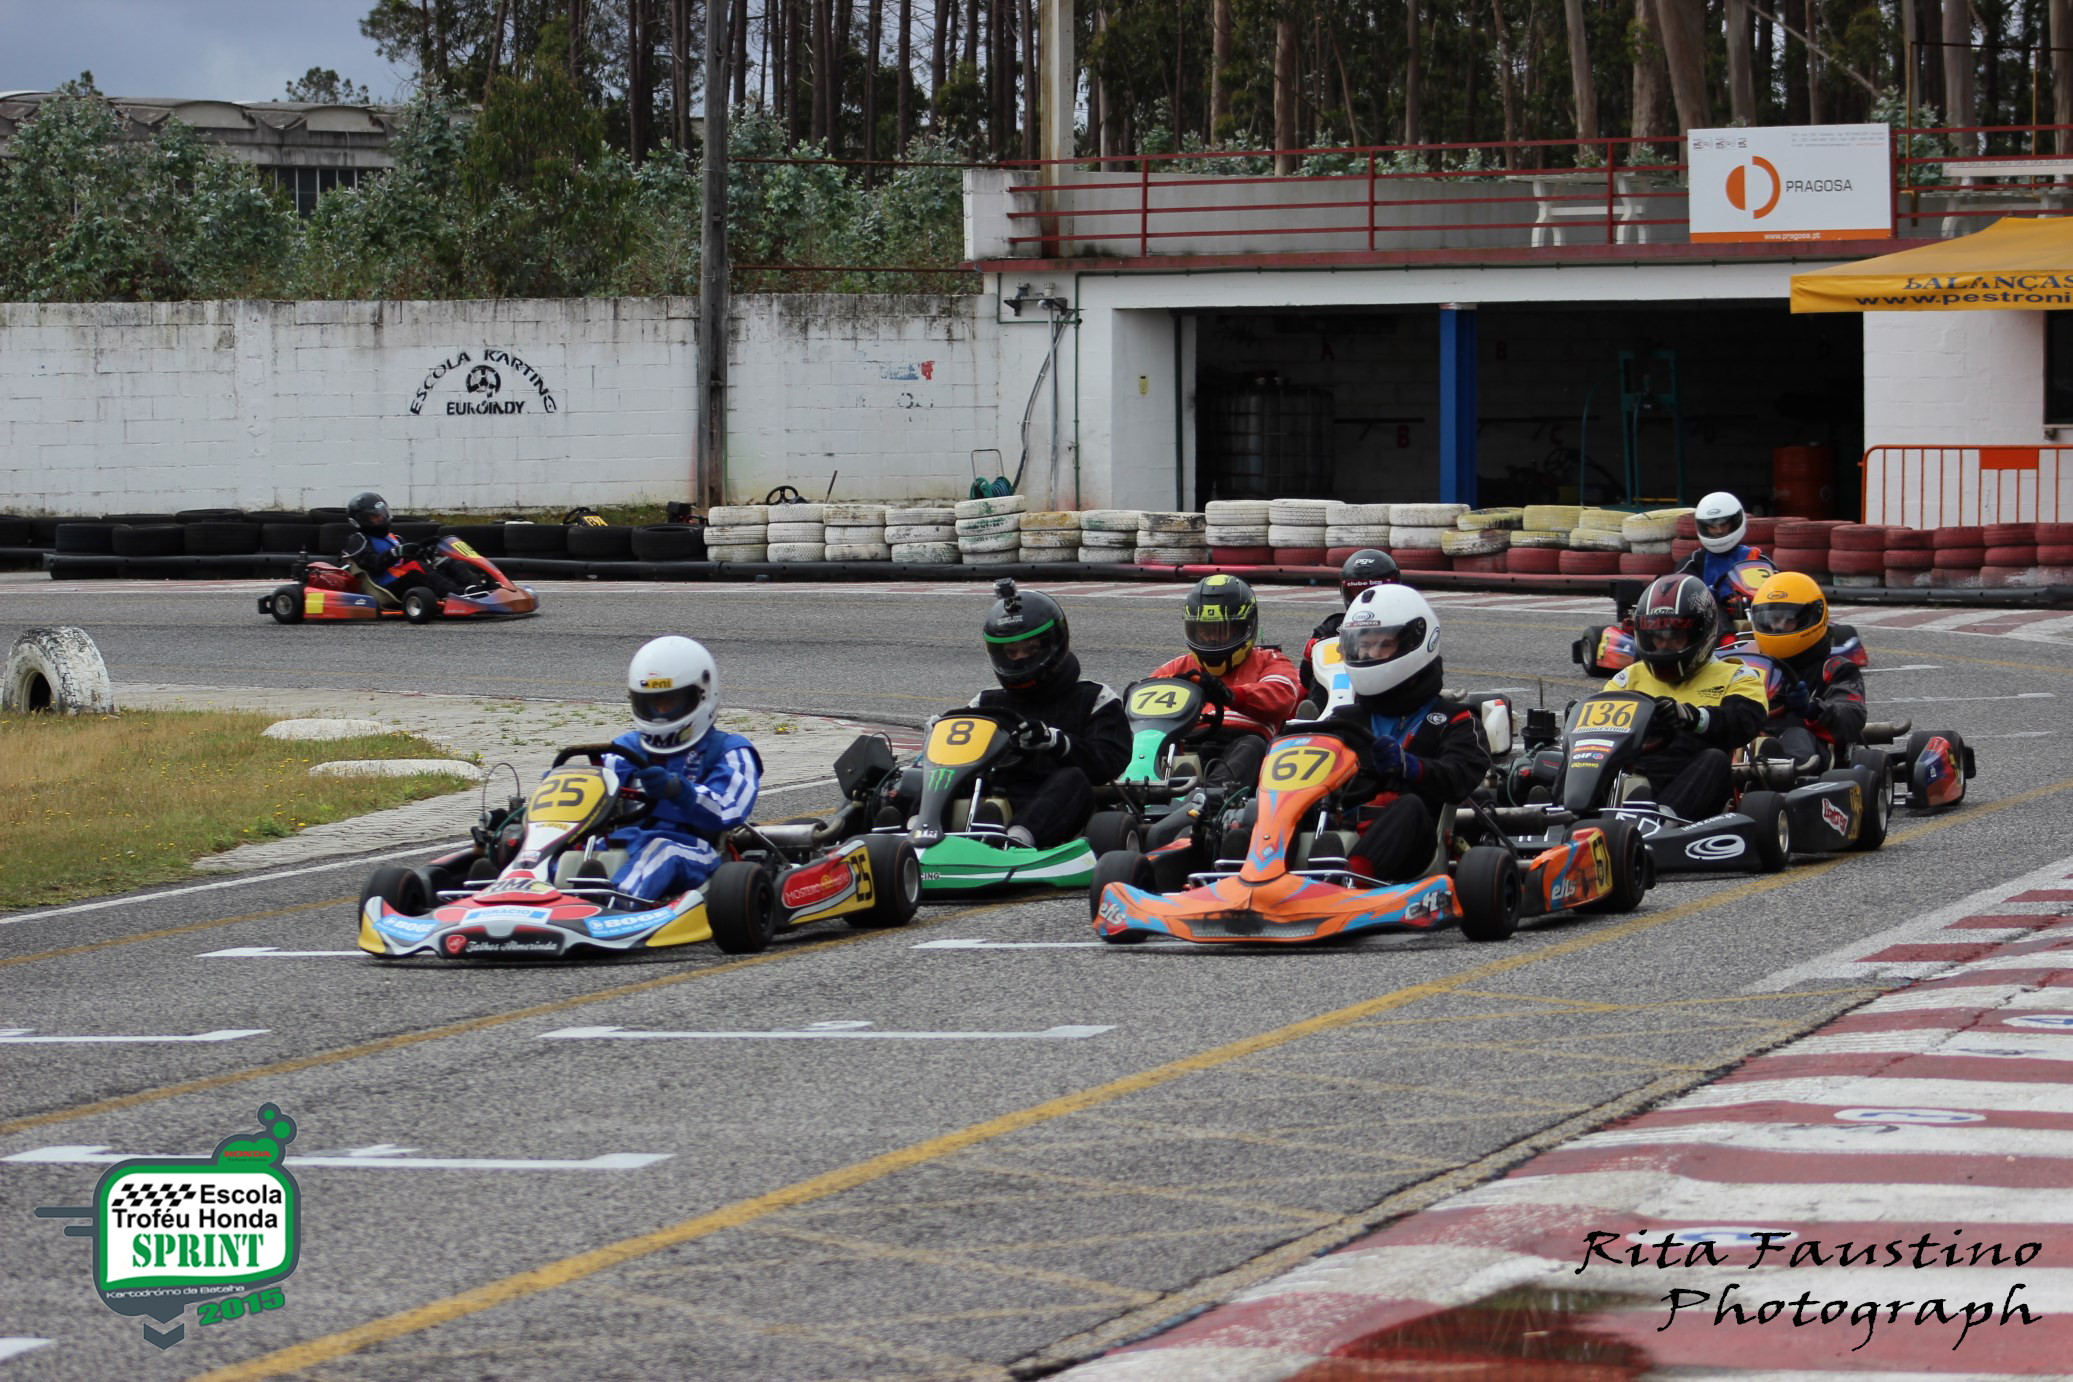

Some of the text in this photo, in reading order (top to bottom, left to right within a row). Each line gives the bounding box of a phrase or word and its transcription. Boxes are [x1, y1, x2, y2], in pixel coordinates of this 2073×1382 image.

[1785, 178, 1853, 193] PRAGOSA
[1763, 231, 1821, 241] www.pragosa.pt
[410, 349, 558, 415] ESCOLA KARTING
[446, 400, 526, 415] EUROINDY
[1137, 691, 1177, 710] 74
[1577, 702, 1634, 727] 136
[946, 720, 975, 745] 8
[1271, 749, 1330, 781] 67
[531, 777, 588, 812] 25
[393, 919, 436, 933] BOGE
[603, 909, 669, 928] BOGE
